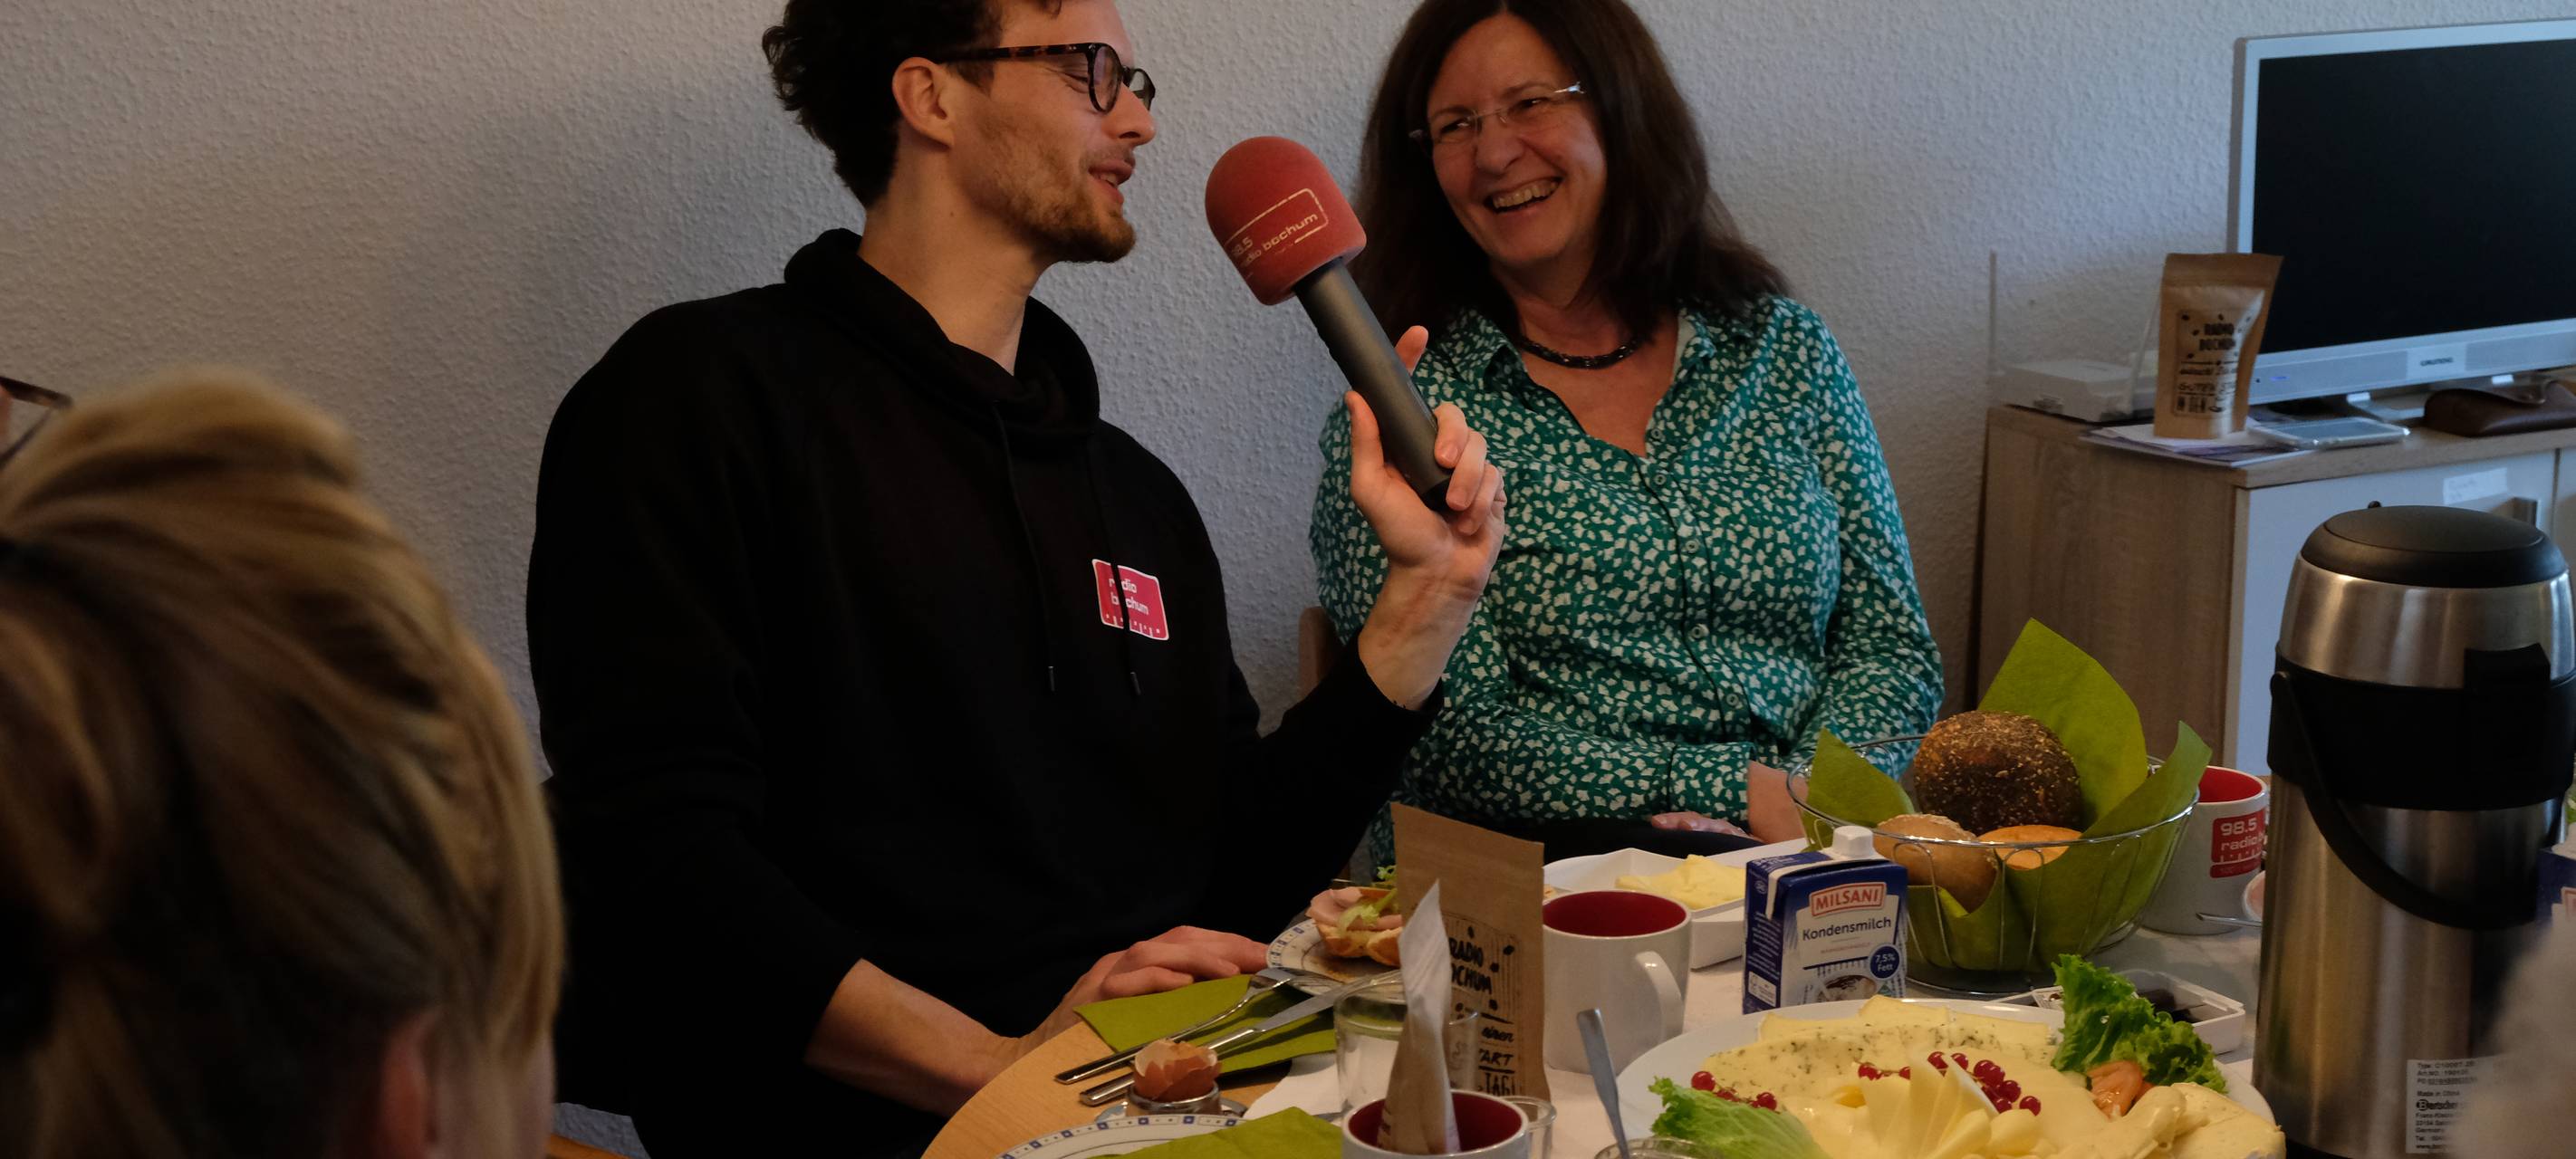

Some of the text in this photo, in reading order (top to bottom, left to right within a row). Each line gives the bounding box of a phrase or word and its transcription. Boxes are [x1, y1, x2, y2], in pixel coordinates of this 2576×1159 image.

[1263, 213, 1318, 252] bochum
[1109, 578, 1138, 594] rdio
[1110, 591, 1149, 616] bchum
[2220, 818, 2258, 837] 98.5
[1815, 888, 1879, 911] MILSANI
[1802, 916, 1892, 942] Kondensmilch
[1876, 953, 1897, 964] 7,5%
[1878, 963, 1894, 972] Fett
